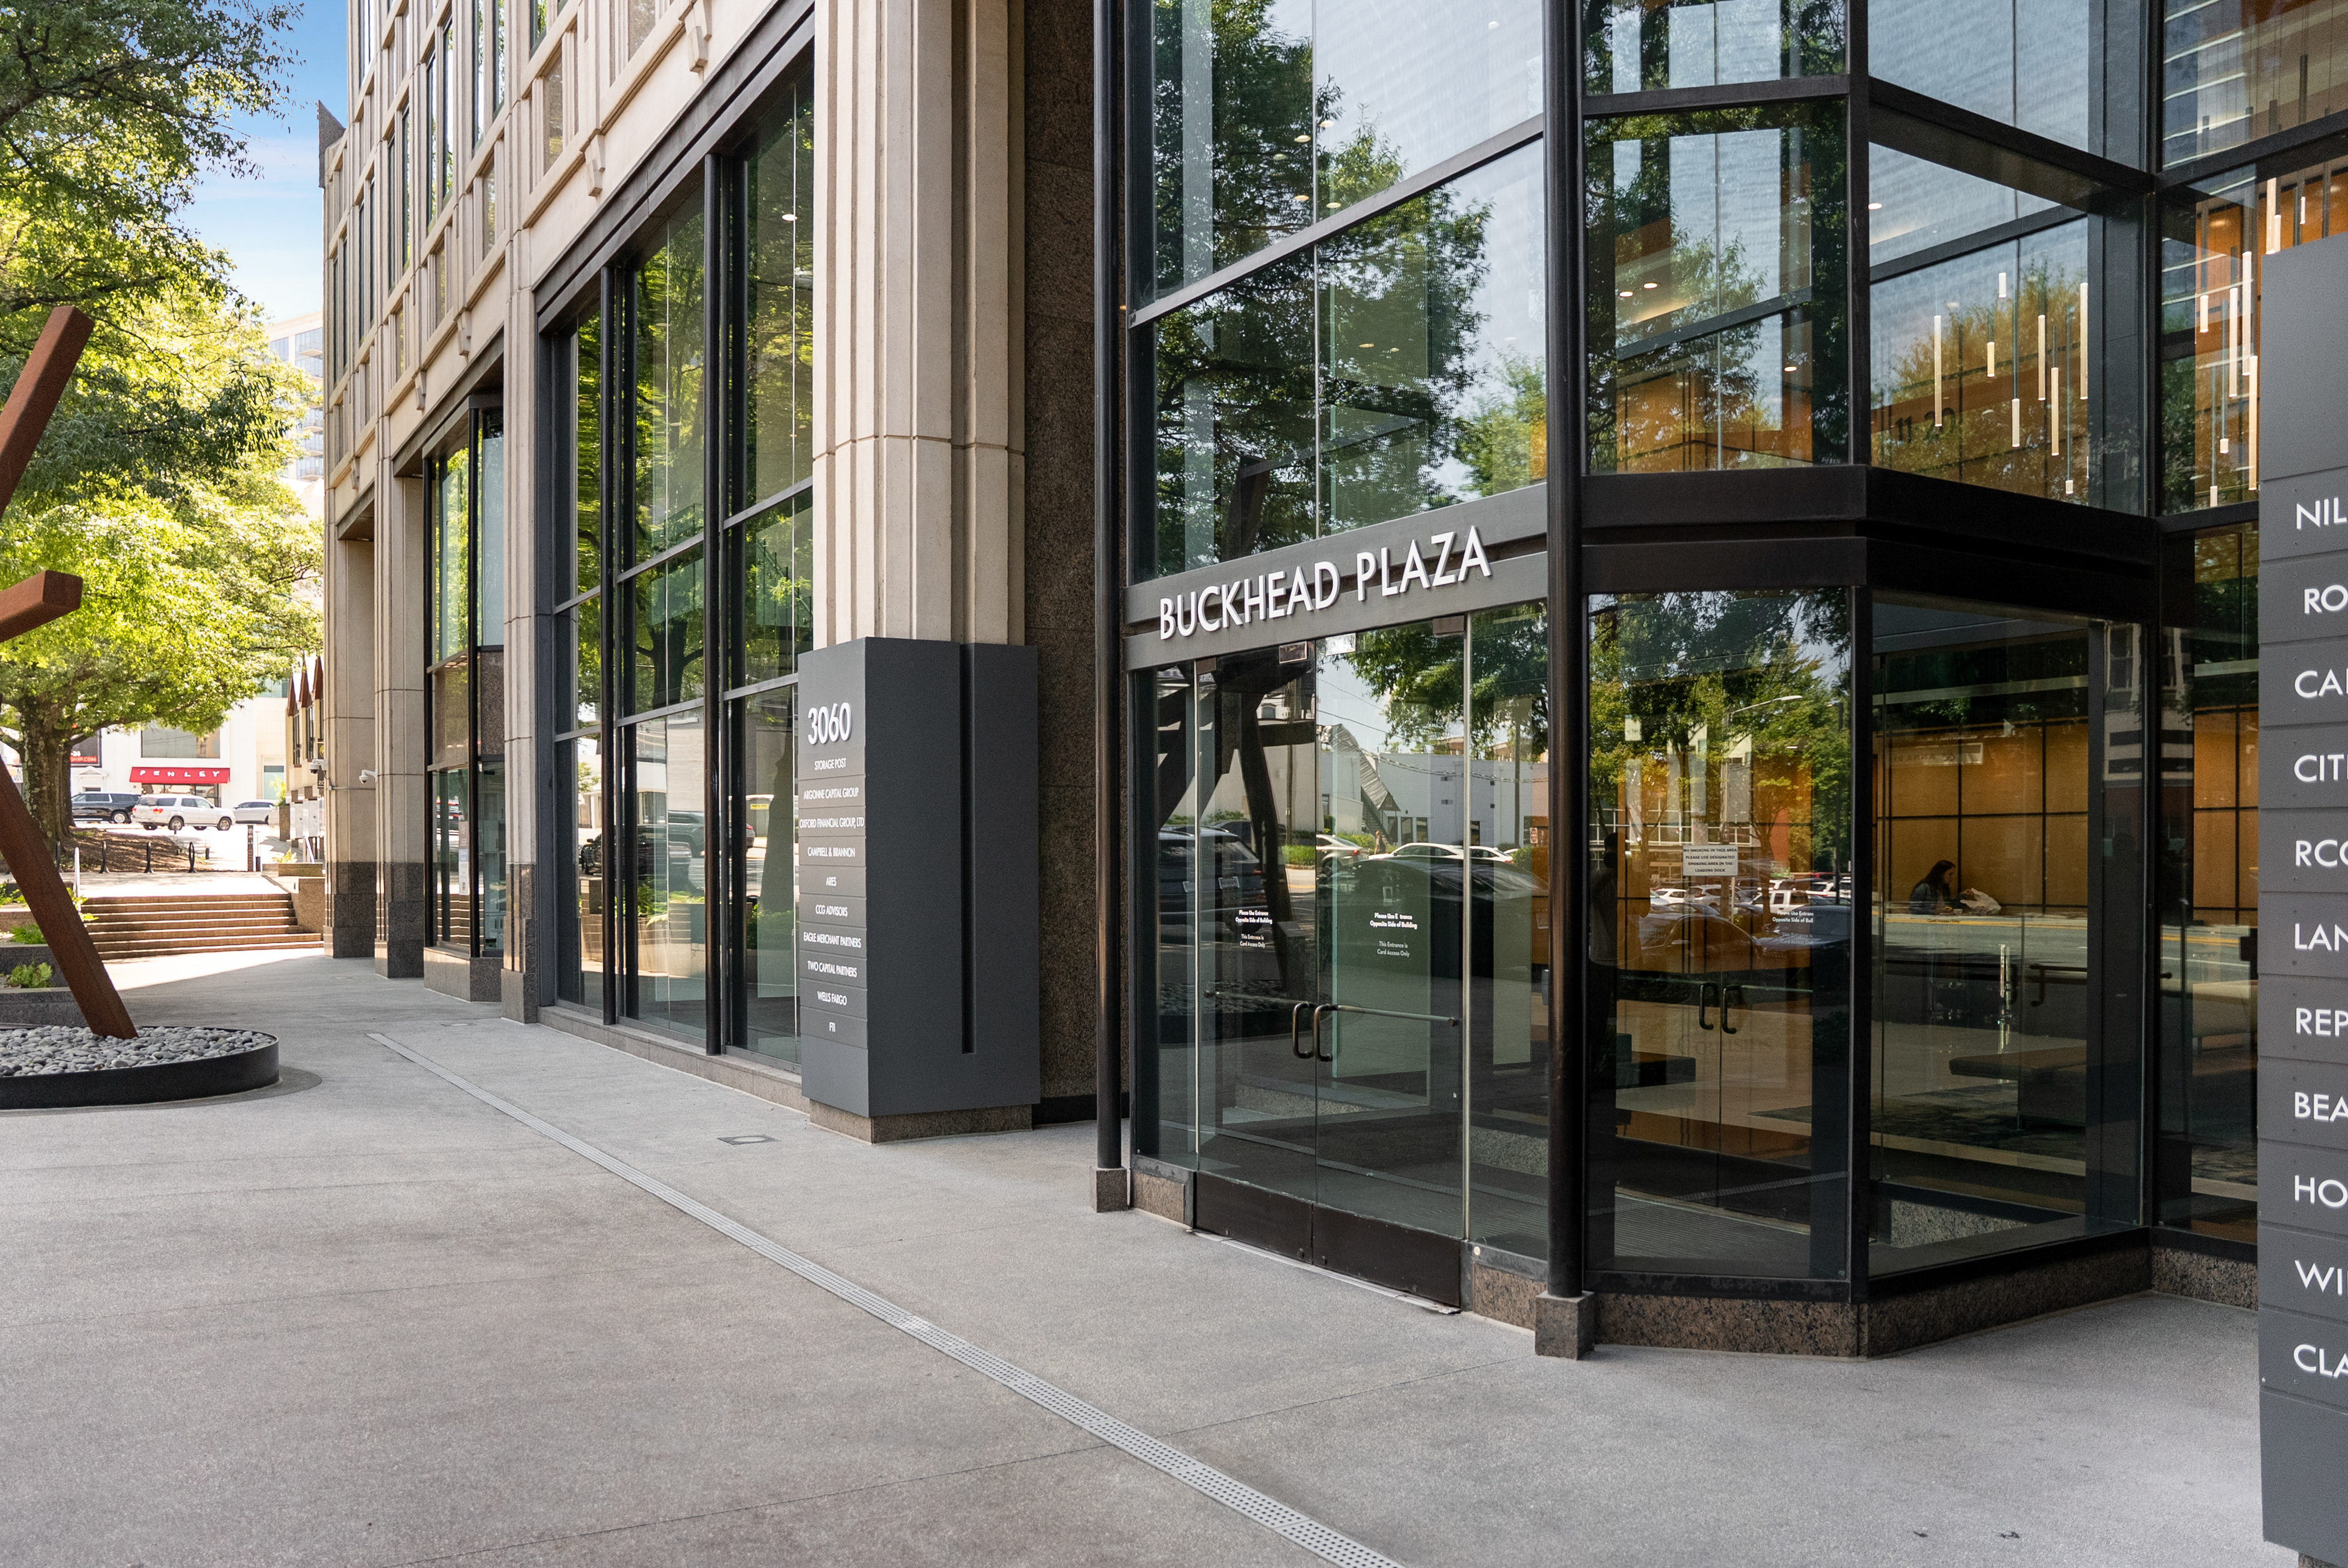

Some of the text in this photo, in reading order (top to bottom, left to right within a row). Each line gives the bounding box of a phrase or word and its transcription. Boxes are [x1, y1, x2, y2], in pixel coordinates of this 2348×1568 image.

[2296, 496, 2347, 529] NIL
[1160, 525, 1492, 640] BUCKHEAD PLAZA
[2304, 584, 2348, 614] RO
[2295, 669, 2348, 698] CA
[808, 702, 852, 745] 3060
[815, 758, 846, 771] STORAGE POST
[2294, 754, 2348, 782] CIT
[804, 787, 859, 800] ARGONNE CAPITAL GROUP
[799, 819, 817, 828] OXFORD
[817, 818, 839, 828] FINANCIAL
[839, 817, 856, 829] GROUP,
[808, 847, 855, 857] CAMPBELL & BRANNON
[826, 877, 836, 887] ARES
[815, 904, 848, 917] CCG ADVISORS
[804, 932, 861, 948] EAGLE MERCHANT PARTNERS
[808, 961, 857, 978] TWO CAPITAL PARTNERS
[817, 991, 848, 1006] WELLS FARGO
[2295, 1091, 2348, 1122] BEA
[2295, 1175, 2348, 1209] HO
[2295, 1261, 2348, 1295] WI
